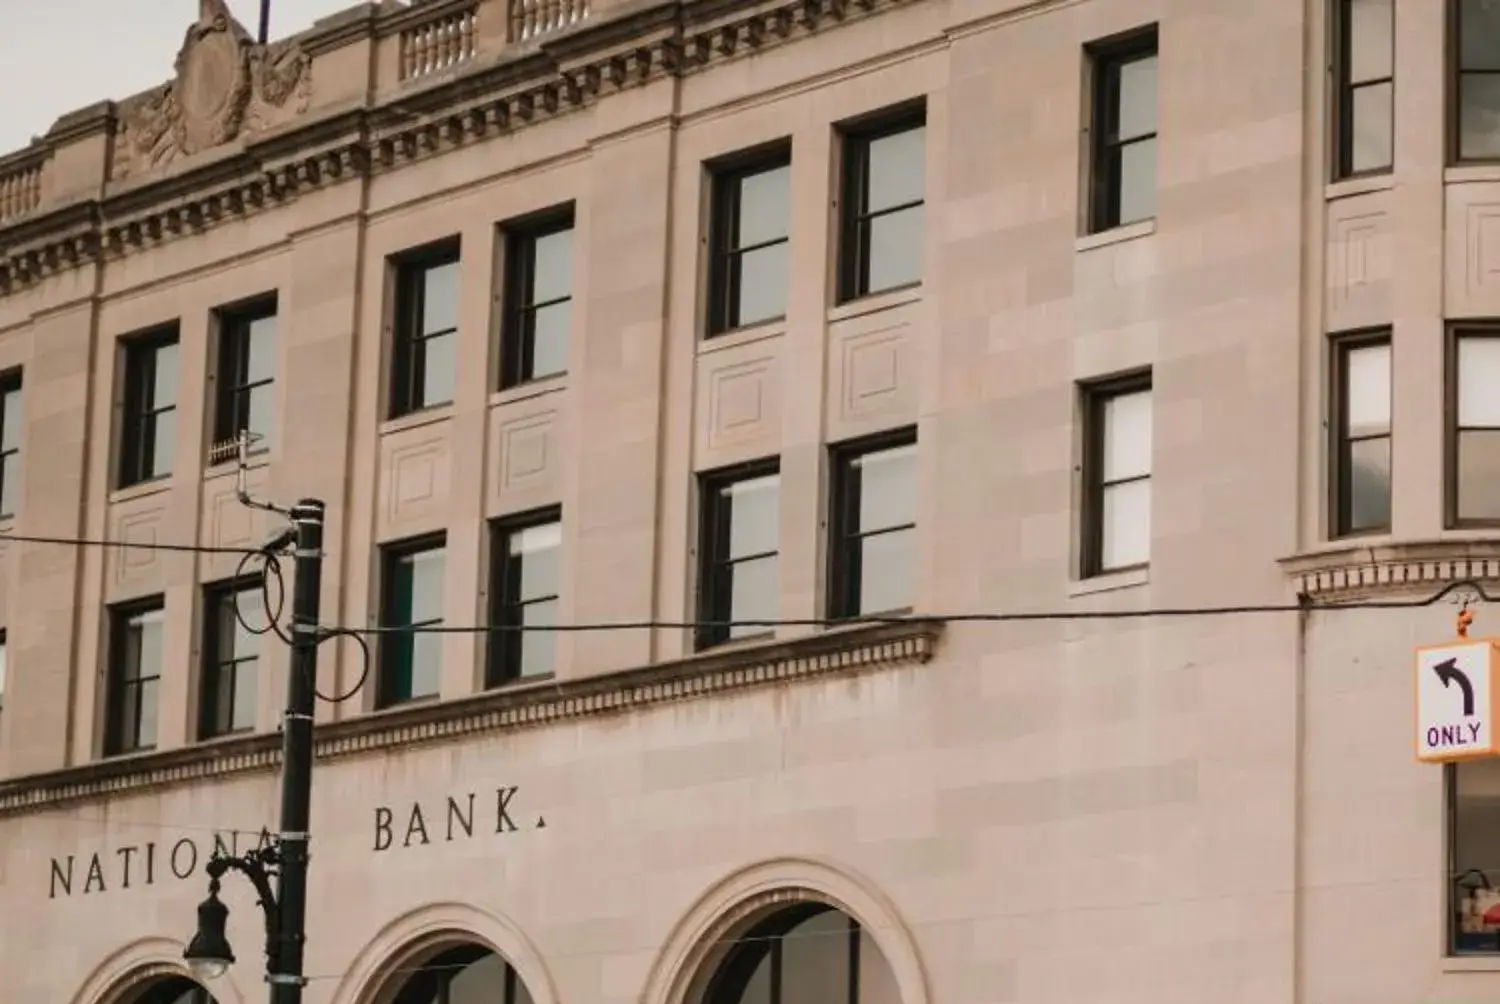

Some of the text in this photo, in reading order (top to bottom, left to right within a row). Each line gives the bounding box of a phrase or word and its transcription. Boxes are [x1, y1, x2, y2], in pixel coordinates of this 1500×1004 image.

[1427, 721, 1481, 747] ONLY
[48, 785, 547, 899] NATIONA BANK.
